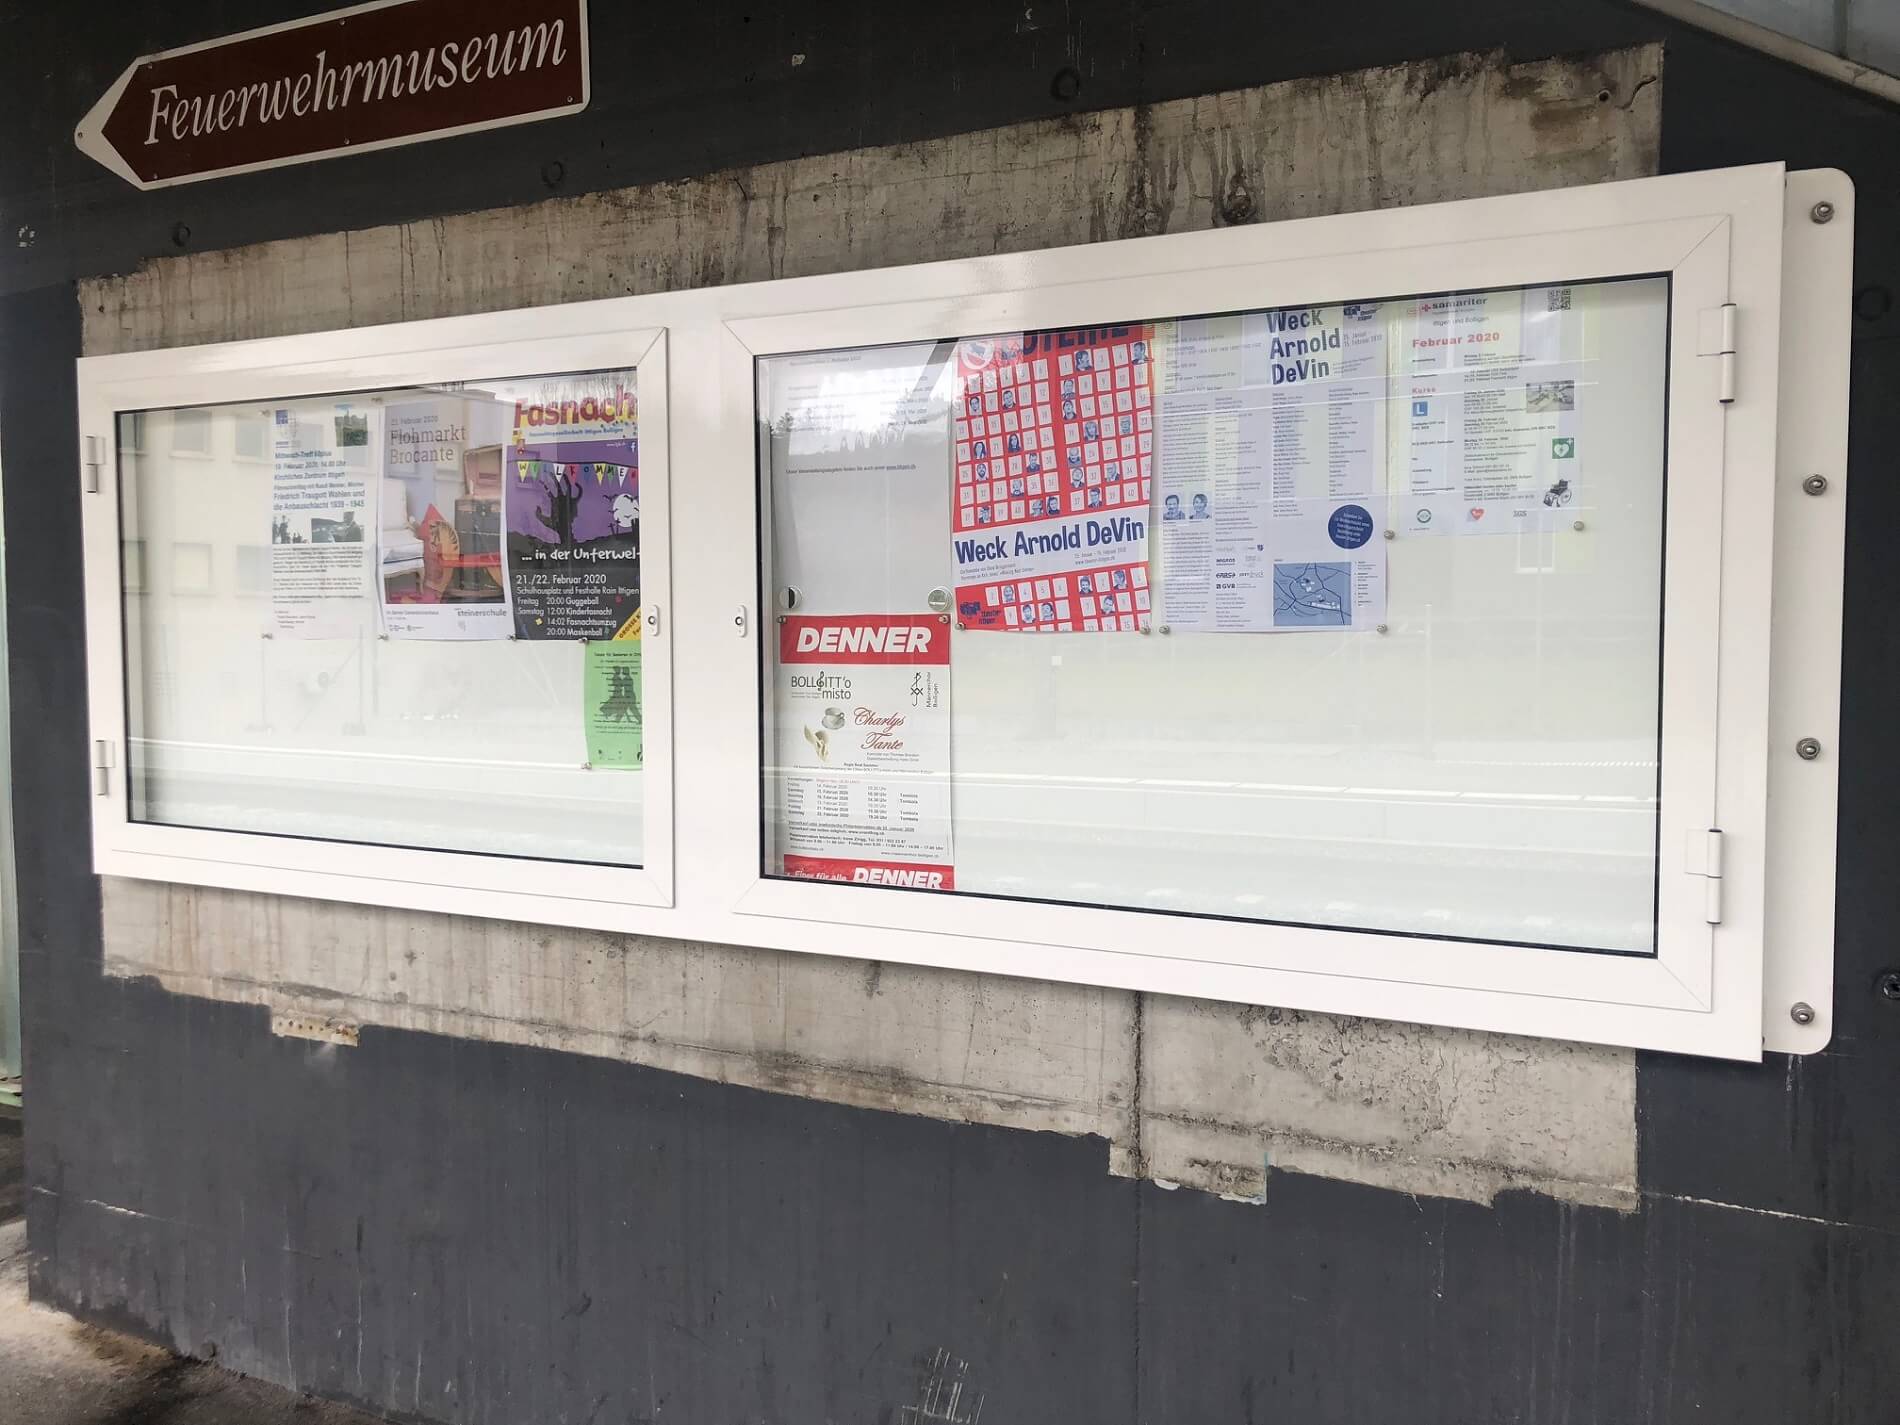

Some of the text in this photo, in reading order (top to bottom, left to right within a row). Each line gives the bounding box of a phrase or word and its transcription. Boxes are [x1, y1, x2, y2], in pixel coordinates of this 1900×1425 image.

[144, 18, 567, 145] Feuerwehrmuseum
[1266, 309, 1324, 333] Weck
[1269, 327, 1341, 360] Arnold
[1412, 332, 1500, 349] Februar 2020
[1271, 358, 1330, 385] DeVin
[391, 424, 467, 446] Flohmarkt
[390, 446, 454, 465] Brocante
[955, 517, 1145, 564] Weck Arnold DeVin
[535, 549, 547, 560] in
[550, 549, 571, 561] der
[516, 573, 607, 586] 21./22. Februar 2020
[516, 586, 562, 596] Schulhausplatz
[563, 586, 574, 595] und
[618, 585, 640, 597] Ittigen
[517, 596, 600, 607] Freitag 20:00 Guggeball
[518, 607, 613, 617] Samstag 12:00 Kinderfasnacht
[546, 627, 603, 636] 20:00 Maskenball
[566, 617, 617, 628] Fasnachtsumzug
[796, 626, 932, 653] DENNER
[822, 688, 852, 700] misto
[853, 706, 905, 733] Charlys
[860, 731, 904, 750] Tante
[853, 867, 944, 890] DENNER
